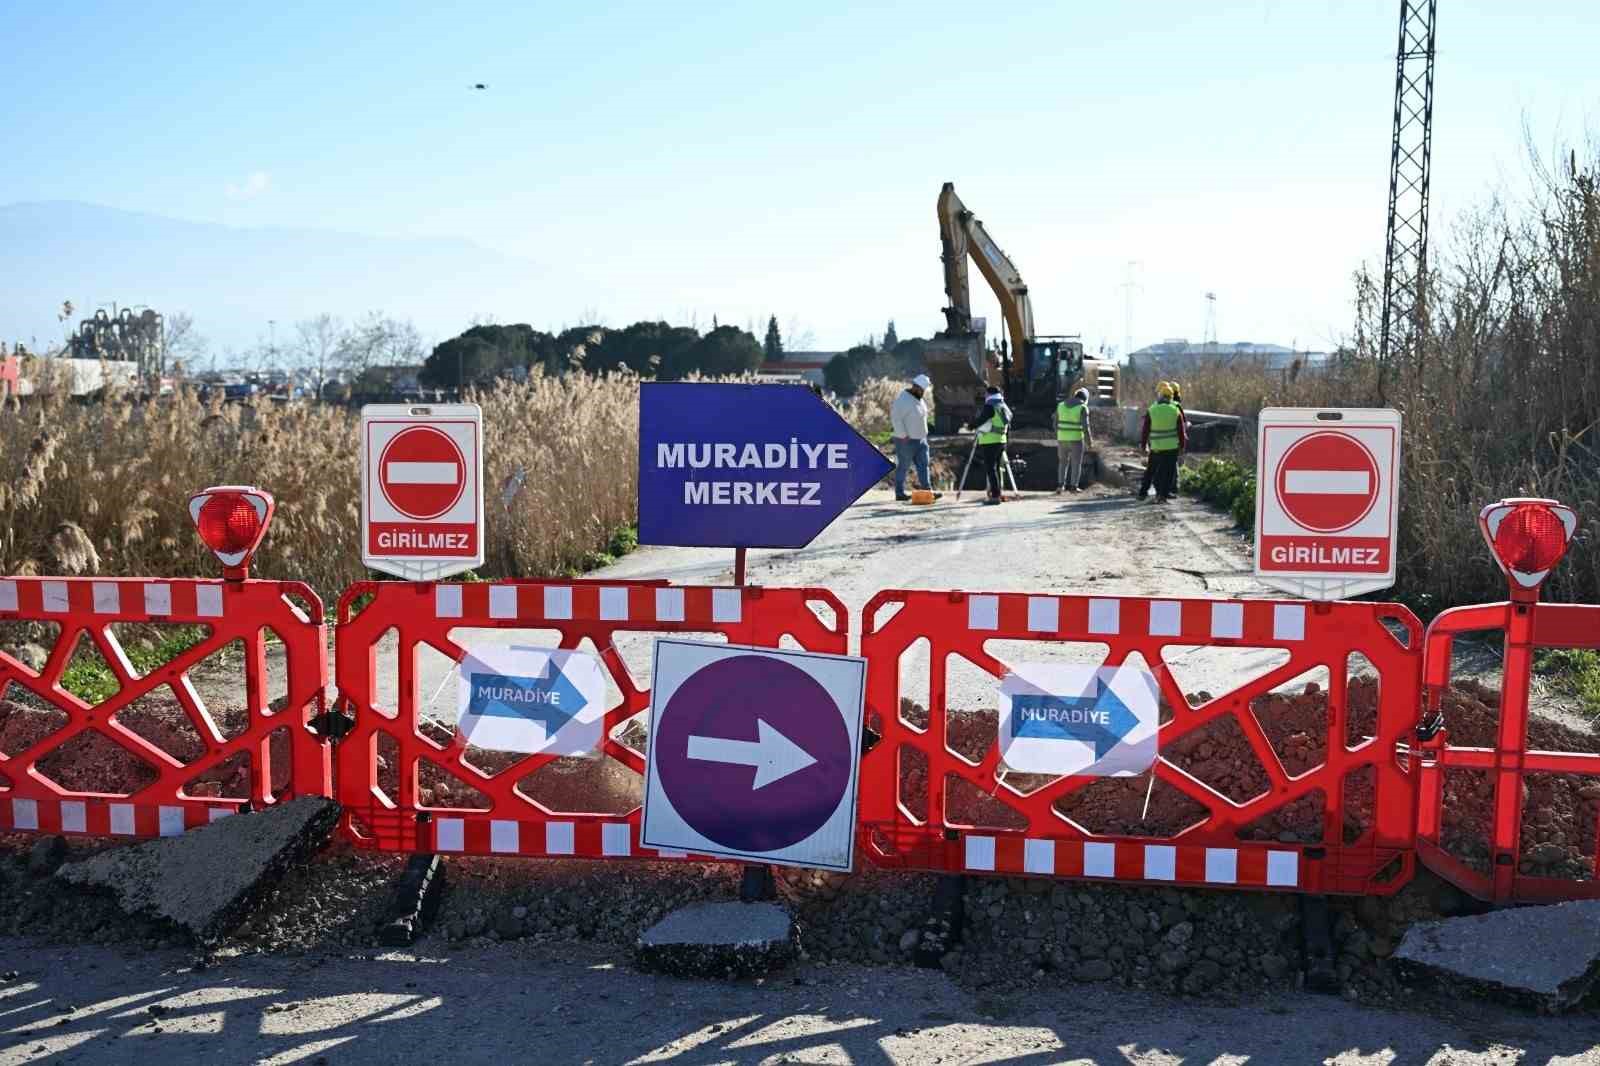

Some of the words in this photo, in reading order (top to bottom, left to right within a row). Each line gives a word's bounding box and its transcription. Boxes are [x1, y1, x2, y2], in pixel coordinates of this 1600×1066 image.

[656, 437, 849, 469] MURADİYE
[683, 481, 822, 506] MERKEZ
[377, 528, 469, 549] GİRİLMEZ
[1271, 541, 1380, 565] GİRİLMEZ
[478, 685, 561, 705] MURADİYE
[1020, 707, 1111, 725] MURADİYE
